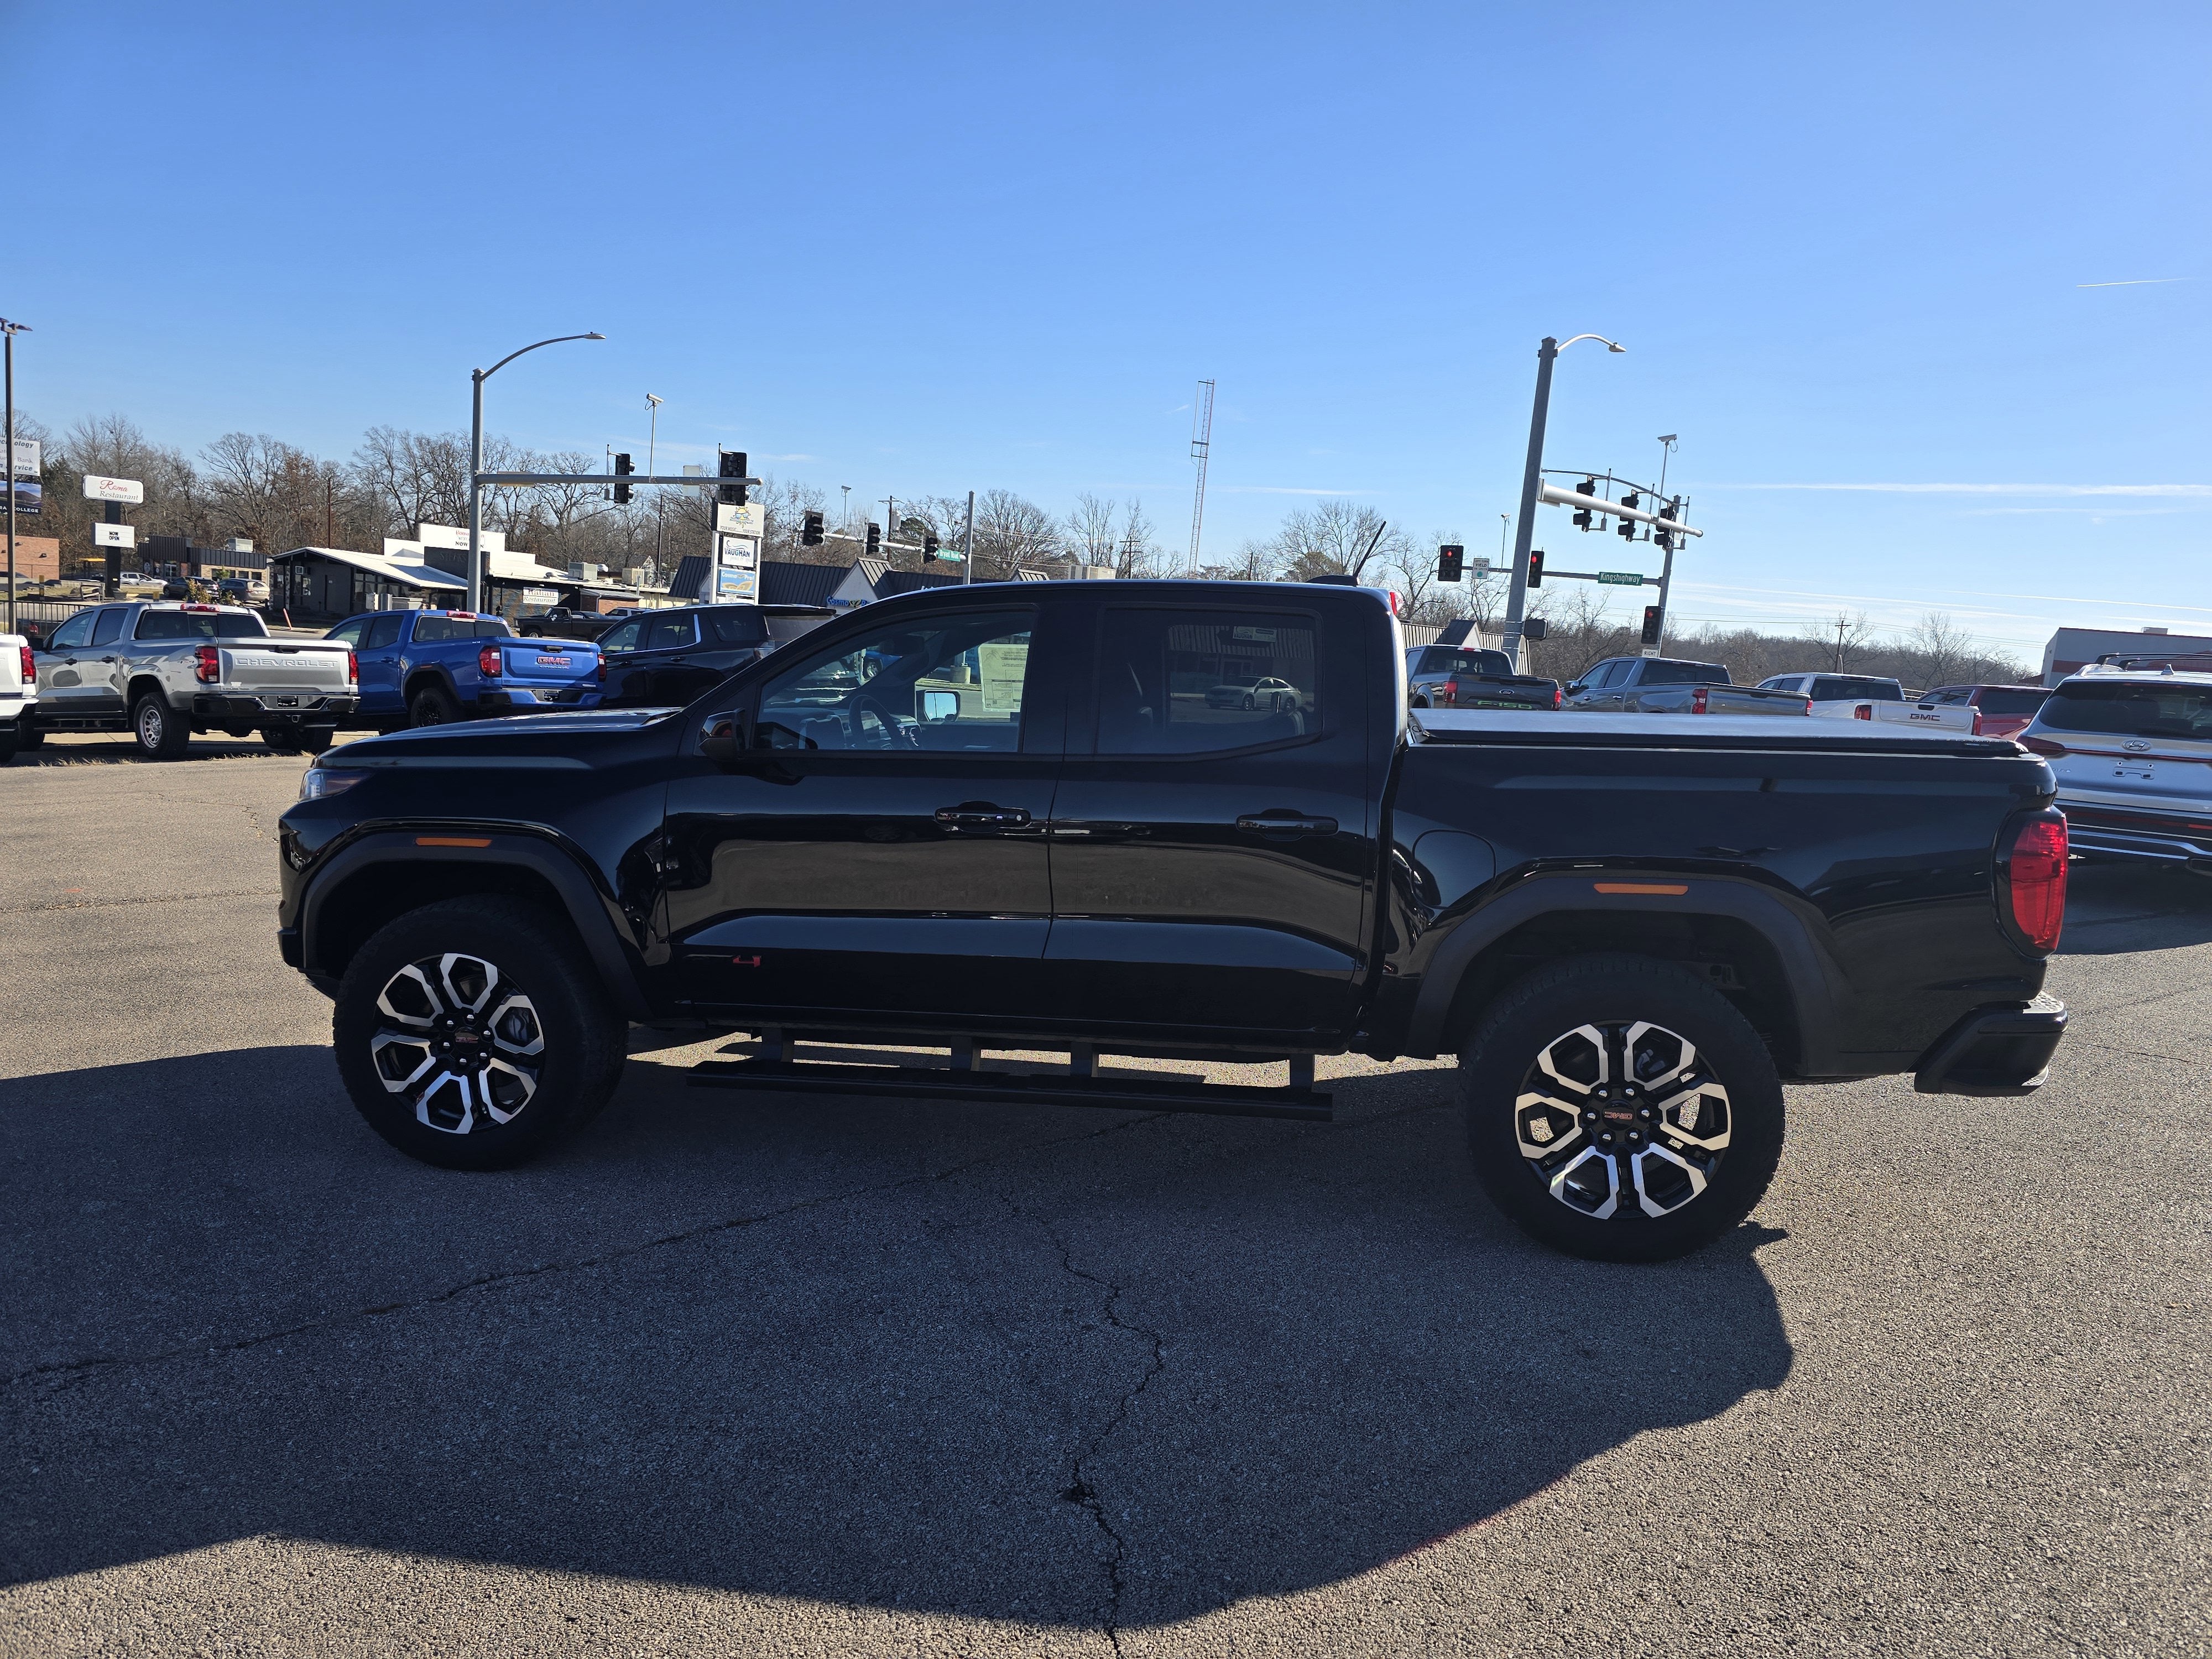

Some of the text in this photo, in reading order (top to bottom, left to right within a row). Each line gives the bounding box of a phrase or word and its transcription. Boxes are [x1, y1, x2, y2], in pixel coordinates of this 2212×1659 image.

[99, 479, 128, 492] Roma
[100, 491, 139, 500] Restaurant
[724, 547, 750, 557] VAUGHAN
[940, 549, 950, 559] Bryant
[1600, 572, 1641, 585] Kingshighway
[827, 596, 849, 607] Cosmo
[235, 658, 338, 667] CHEVROLET
[538, 656, 571, 665] GMC
[1477, 700, 1532, 709] F-150
[1604, 1111, 1633, 1120] GMC
